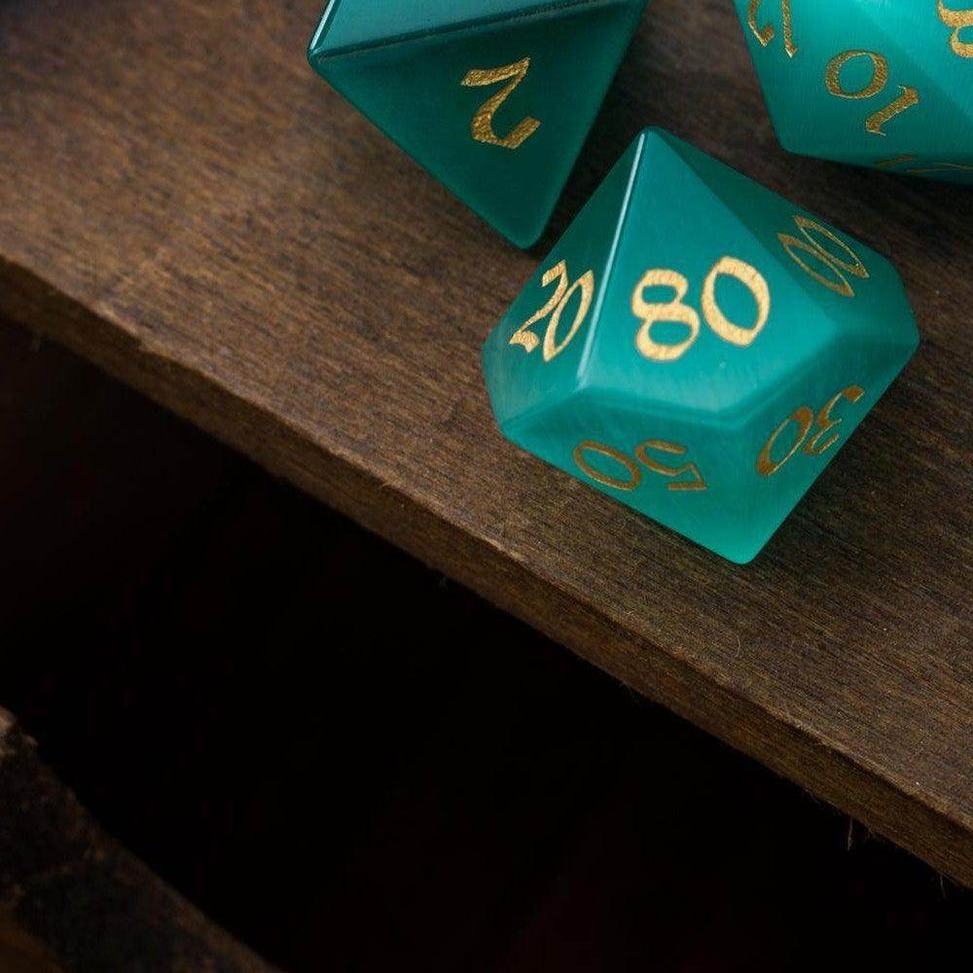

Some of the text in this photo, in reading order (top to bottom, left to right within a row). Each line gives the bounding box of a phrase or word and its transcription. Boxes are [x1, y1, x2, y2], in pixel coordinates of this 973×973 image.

[460, 57, 543, 150] 2
[824, 49, 919, 137] 10
[777, 214, 870, 298] 00
[508, 259, 595, 362] 20
[631, 255, 771, 362] 80
[572, 439, 708, 492] 50
[756, 385, 865, 477] 30
